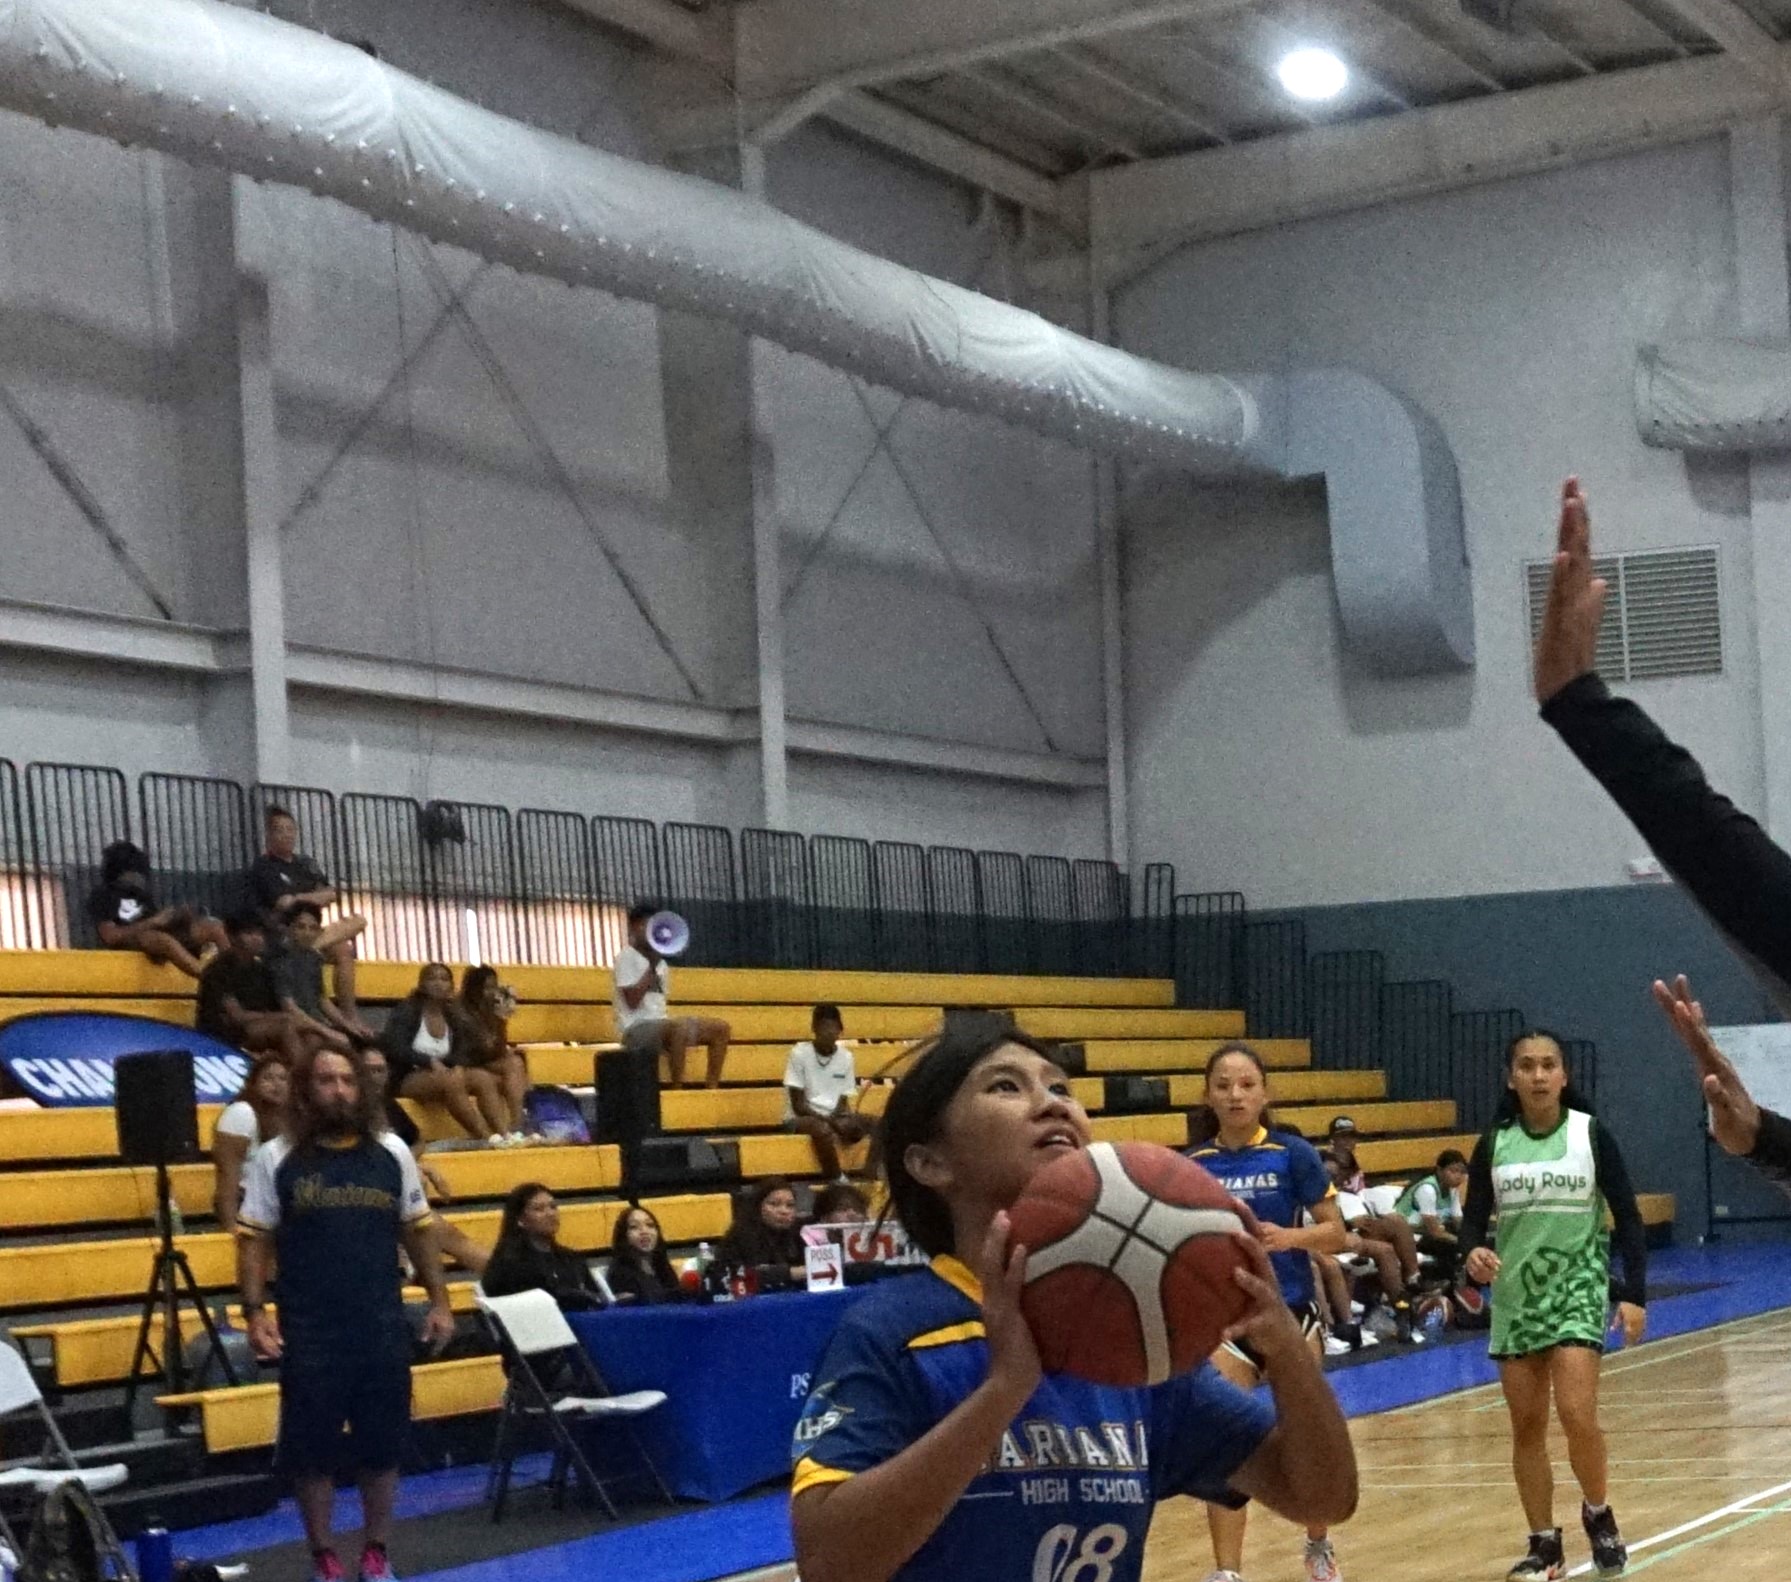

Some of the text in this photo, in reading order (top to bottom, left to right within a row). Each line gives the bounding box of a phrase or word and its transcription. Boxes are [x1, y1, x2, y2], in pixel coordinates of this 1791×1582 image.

[1541, 1171, 1587, 1193] Rays
[1021, 1478, 1144, 1504] HIGH SCHOOL
